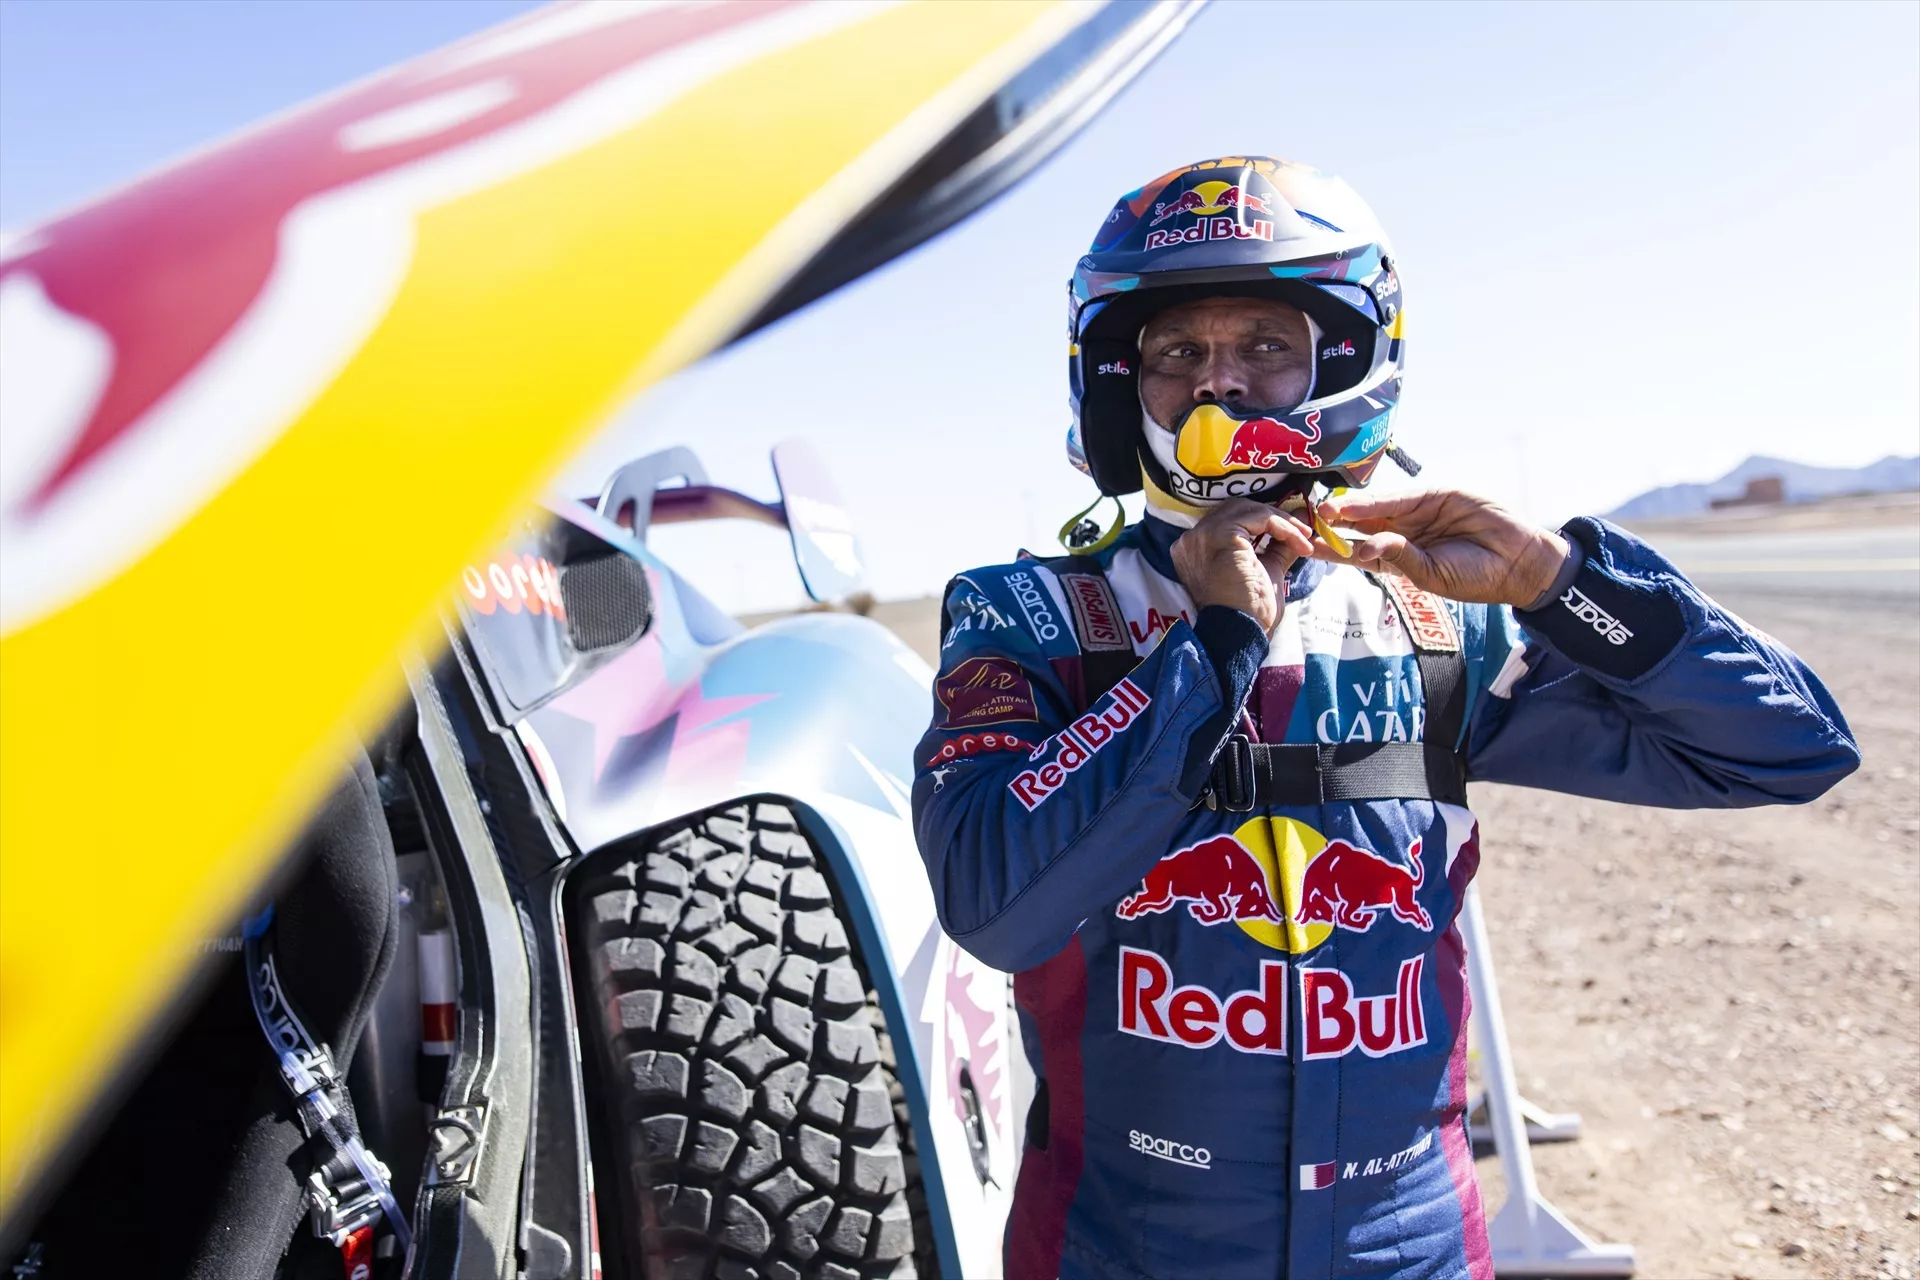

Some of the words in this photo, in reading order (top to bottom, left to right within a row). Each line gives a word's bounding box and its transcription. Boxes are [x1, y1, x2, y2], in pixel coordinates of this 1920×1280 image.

[1144, 217, 1207, 252] Red
[1210, 216, 1274, 242] Bull
[1098, 360, 1130, 375] stilo
[1322, 340, 1356, 359] stilo
[1168, 470, 1267, 500] parco
[1003, 571, 1059, 645] sparco
[1080, 580, 1116, 641] SIMPSON
[987, 705, 1014, 715] CAMP
[1008, 728, 1092, 812] Red
[1070, 677, 1152, 754] Bull
[1118, 945, 1288, 1057] Red
[1302, 953, 1429, 1061] Bull
[1129, 1129, 1211, 1170] sparco
[1342, 1162, 1359, 1179] N.
